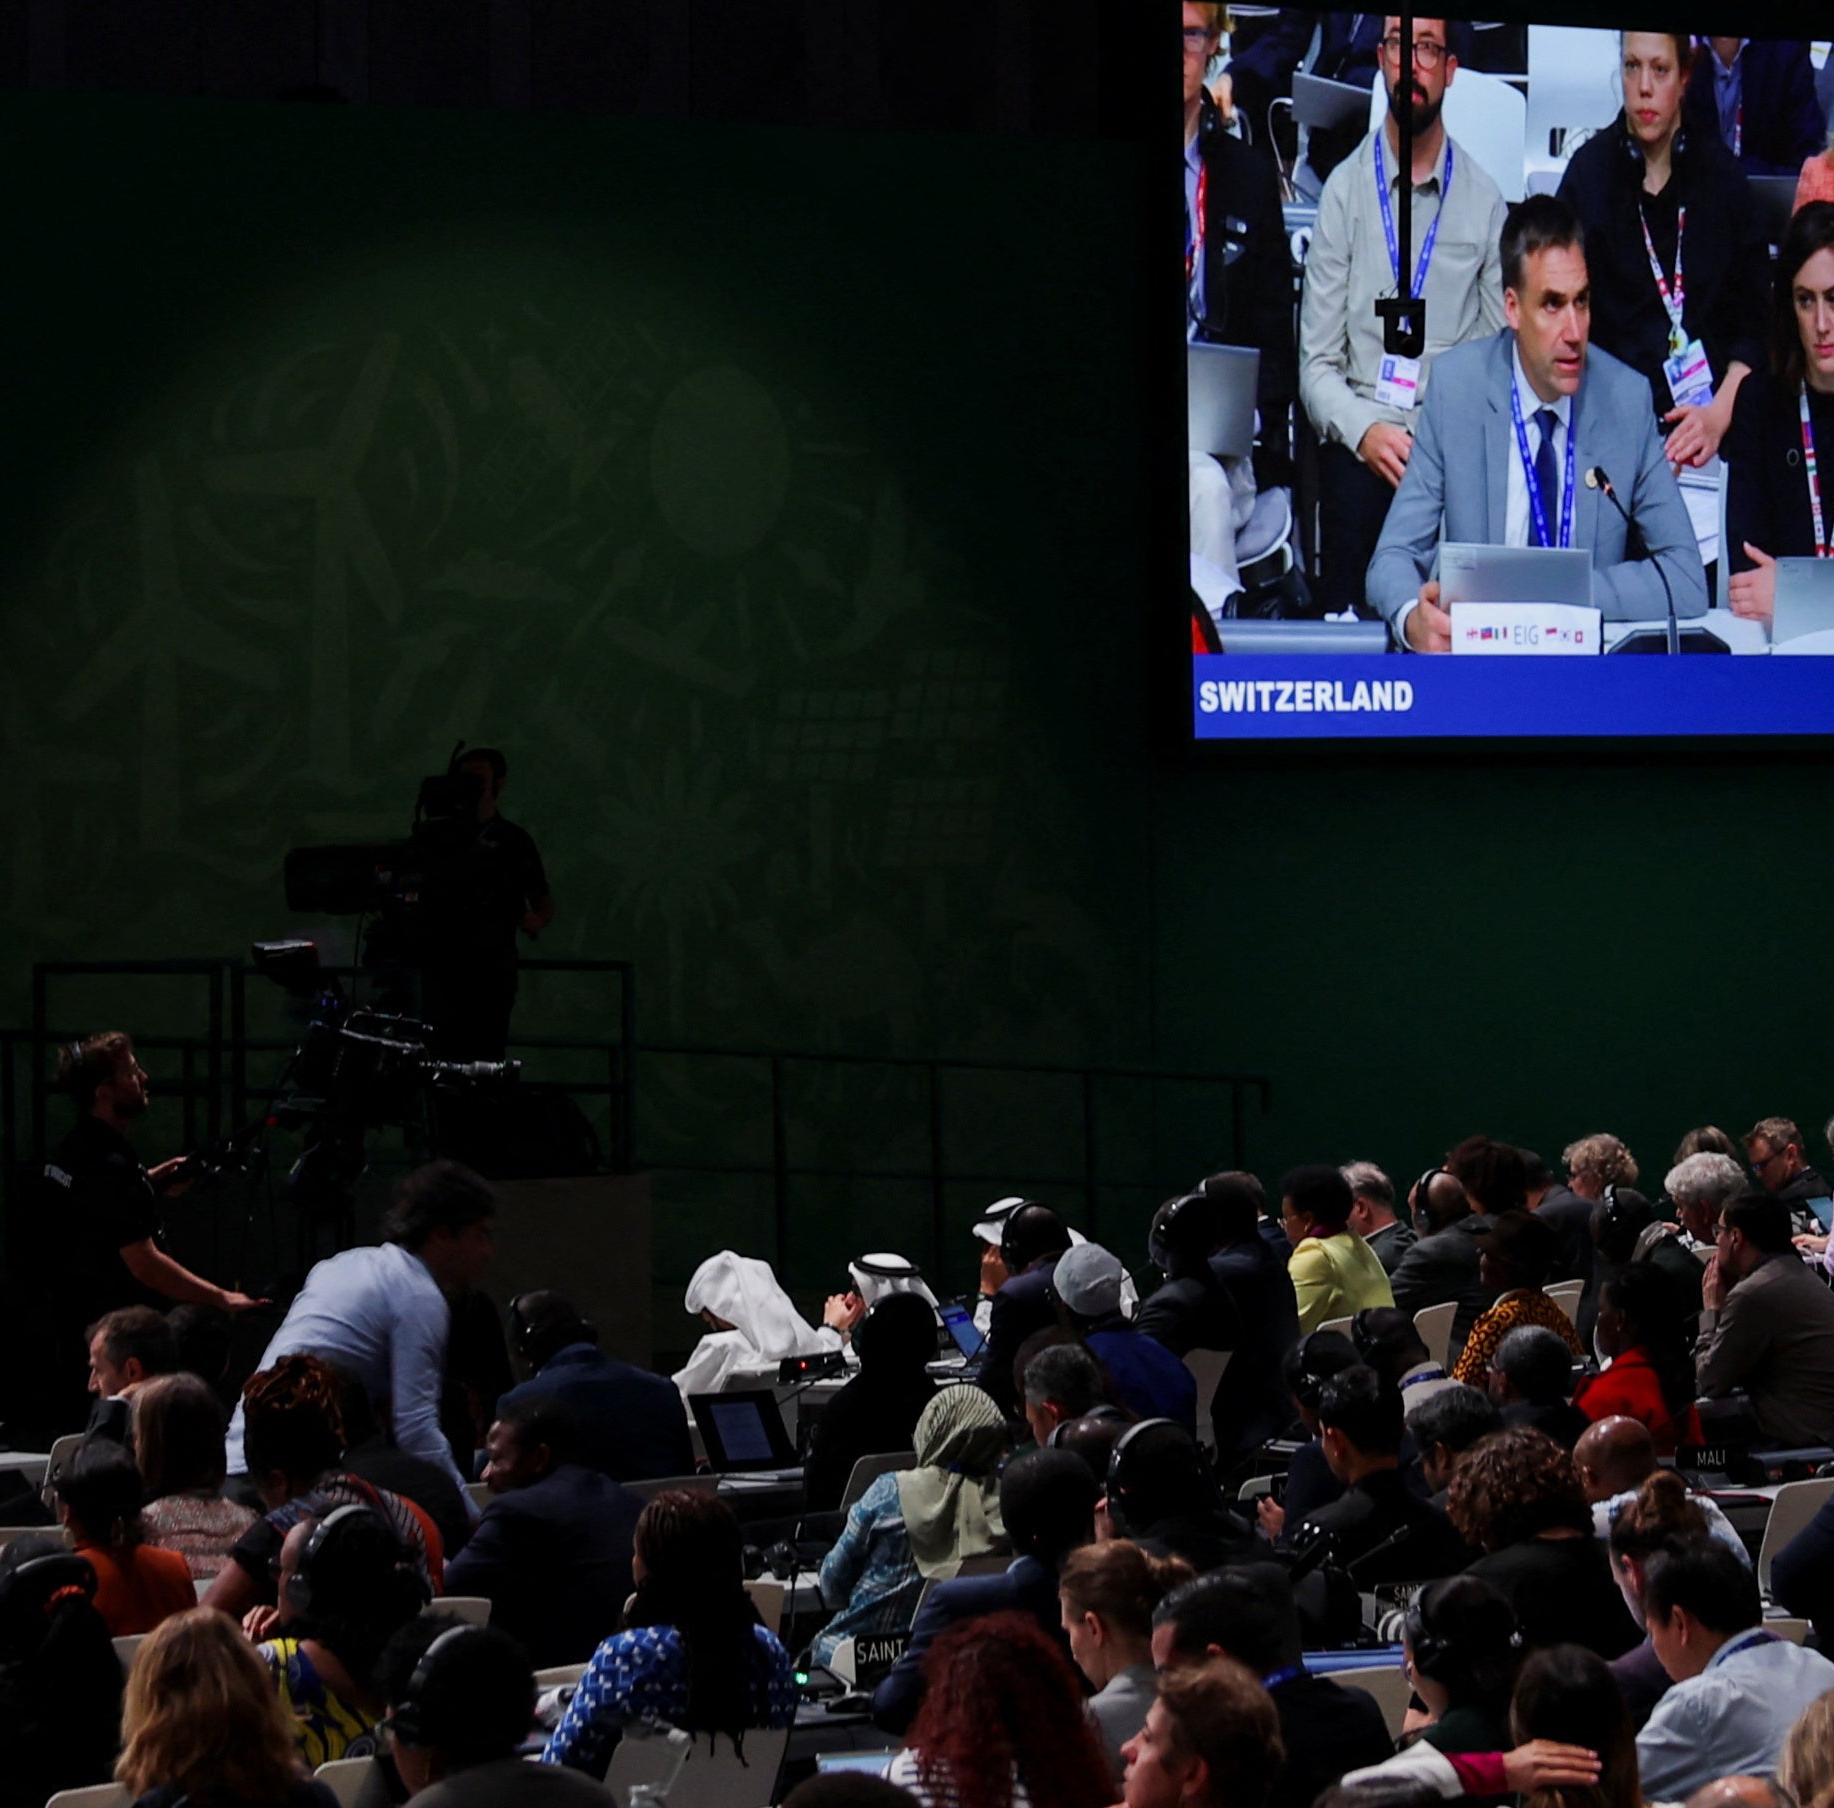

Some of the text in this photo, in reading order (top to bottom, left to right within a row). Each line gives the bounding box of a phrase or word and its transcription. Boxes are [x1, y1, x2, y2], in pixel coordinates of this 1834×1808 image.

[1514, 624, 1539, 646] EIG
[1199, 680, 1414, 713] SWITZERLAND
[1696, 1448, 1726, 1467] MALI
[856, 1637, 905, 1665] SAINT
